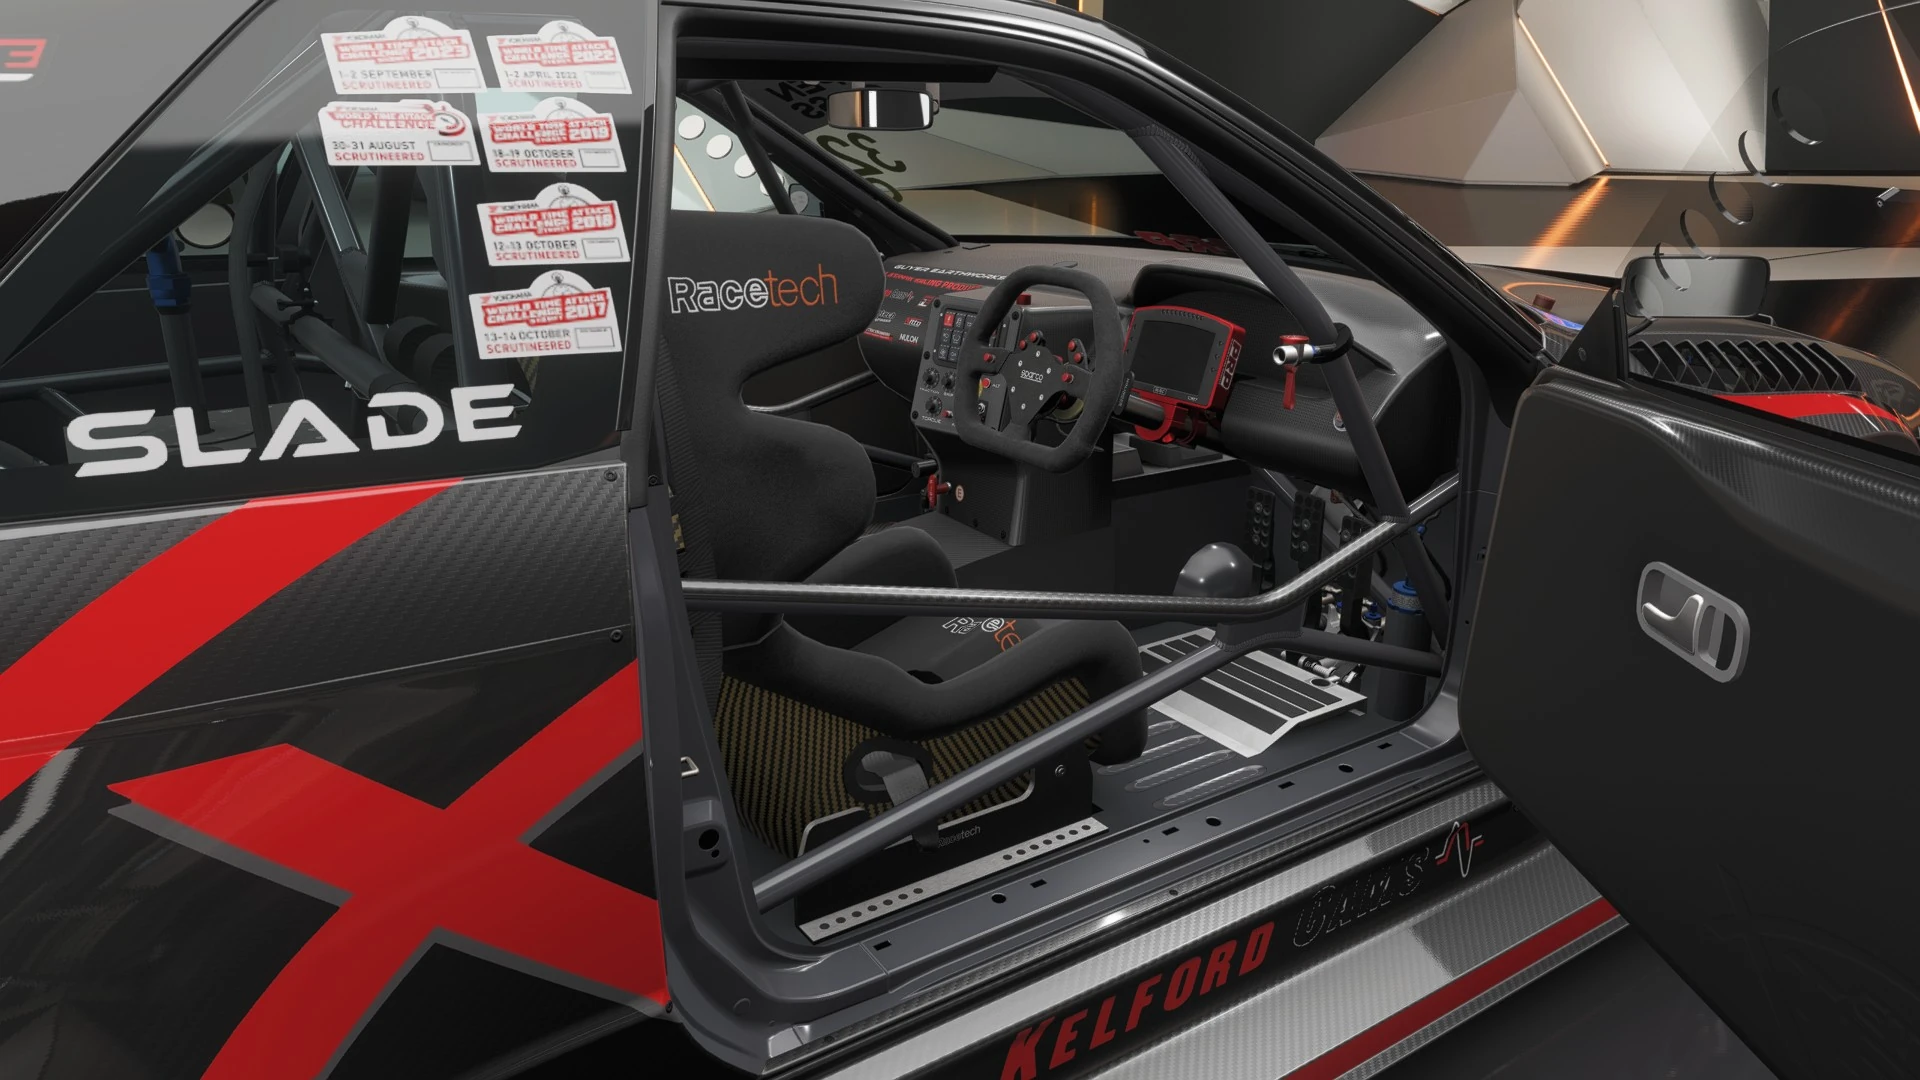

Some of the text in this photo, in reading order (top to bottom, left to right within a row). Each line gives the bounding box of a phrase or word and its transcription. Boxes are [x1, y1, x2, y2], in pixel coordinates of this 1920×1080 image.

[412, 45, 469, 60] 2023
[573, 49, 617, 63] 2022
[361, 69, 434, 79] SEPTEMBER
[523, 71, 552, 79] APRIL
[555, 71, 577, 79] 2022
[342, 80, 432, 90] SCRUTINEERED
[507, 80, 583, 88] SCRUTINEERED
[340, 119, 437, 130] CHALLENGE
[569, 128, 609, 140] 2019
[332, 141, 416, 150] 30-31 AUGUST
[335, 152, 425, 161] SCRUTINEERED
[524, 149, 575, 158] OCTOBER
[495, 159, 577, 168] SCRUTINEERED
[493, 206, 611, 224] WORLD TIME ATTACK
[495, 215, 612, 233] CHALLENGE 2018
[493, 239, 578, 250] 12-13 OCTOBER
[495, 250, 580, 261] SCRUTINEERED
[667, 263, 839, 314] Racetech
[486, 294, 605, 316] WORLD TIME ATTACK
[487, 302, 607, 324] CHALLENGE 2017
[519, 329, 571, 340] OCTOBER
[899, 333, 919, 344] NULON
[486, 340, 572, 354] SCRUTINEERED
[1220, 339, 1242, 390] PRP
[66, 383, 523, 477] SLADE
[1000, 921, 1275, 1080] KELFORD
